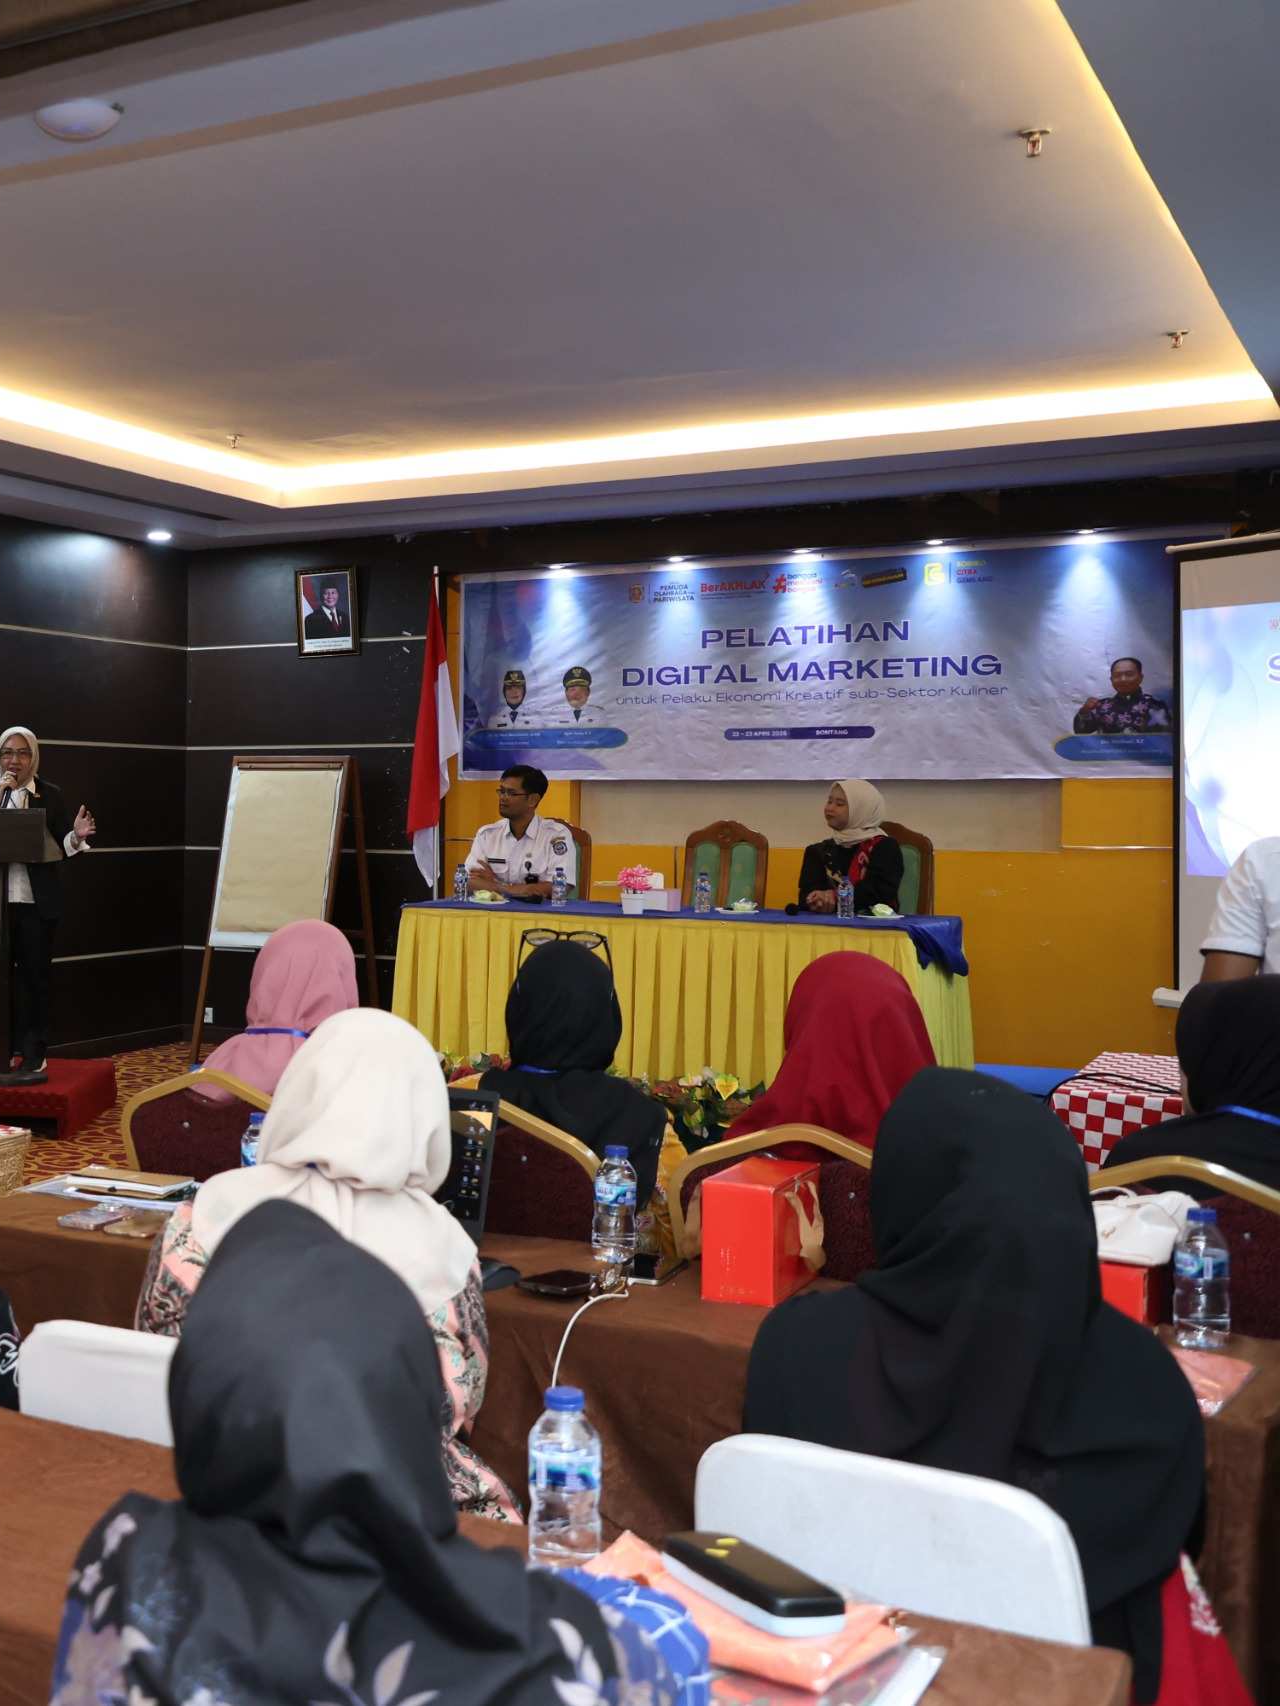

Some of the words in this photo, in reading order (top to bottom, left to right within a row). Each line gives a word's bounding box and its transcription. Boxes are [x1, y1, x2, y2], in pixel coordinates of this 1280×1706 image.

[701, 620, 910, 648] PELATIHAN
[622, 663, 758, 687] DIGITAL
[767, 654, 1002, 682] MARKETING
[615, 694, 657, 706] untuk
[662, 693, 712, 704] Pelaku
[716, 690, 781, 703] Ekonomi
[785, 688, 844, 701] Kreatif
[848, 686, 945, 699] sub-Sektor
[950, 684, 1008, 697] Kuliner
